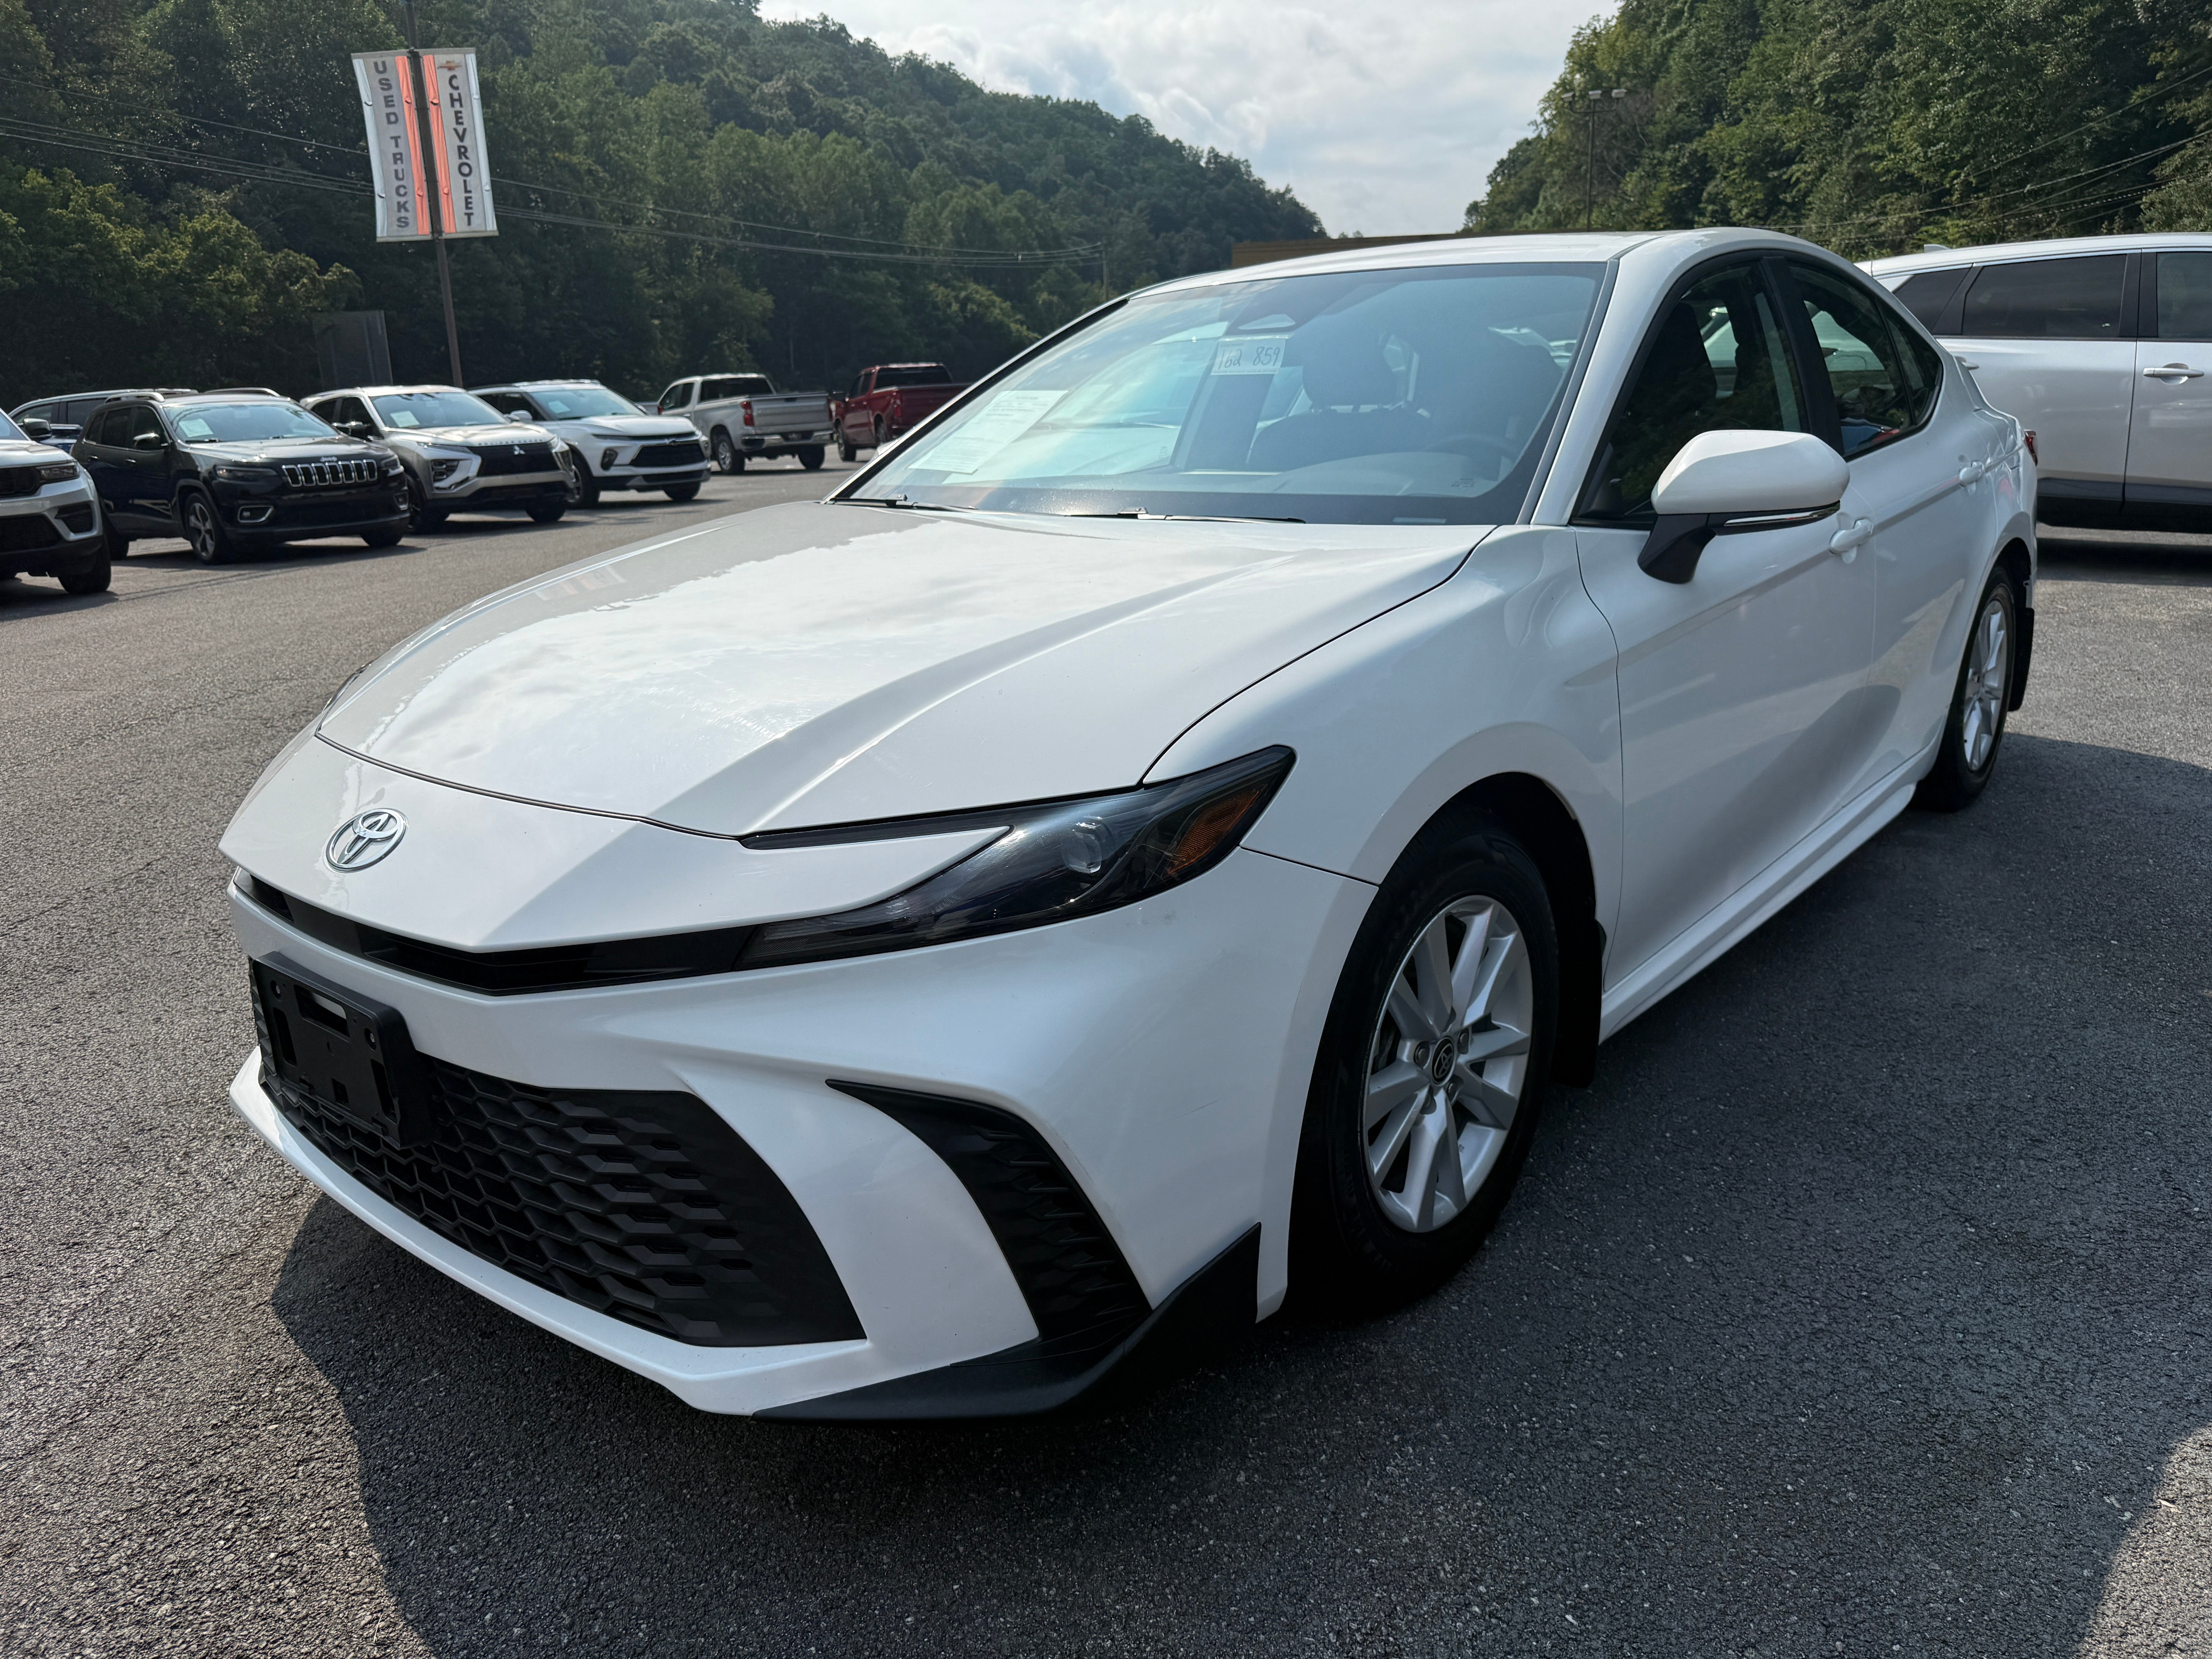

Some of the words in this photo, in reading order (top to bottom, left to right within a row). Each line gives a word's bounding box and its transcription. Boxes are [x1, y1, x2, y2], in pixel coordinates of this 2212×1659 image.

[373, 60, 399, 125] USED
[390, 136, 410, 228] TRUCKS
[448, 75, 474, 226] CHEVROLET
[1252, 346, 1280, 366] 859
